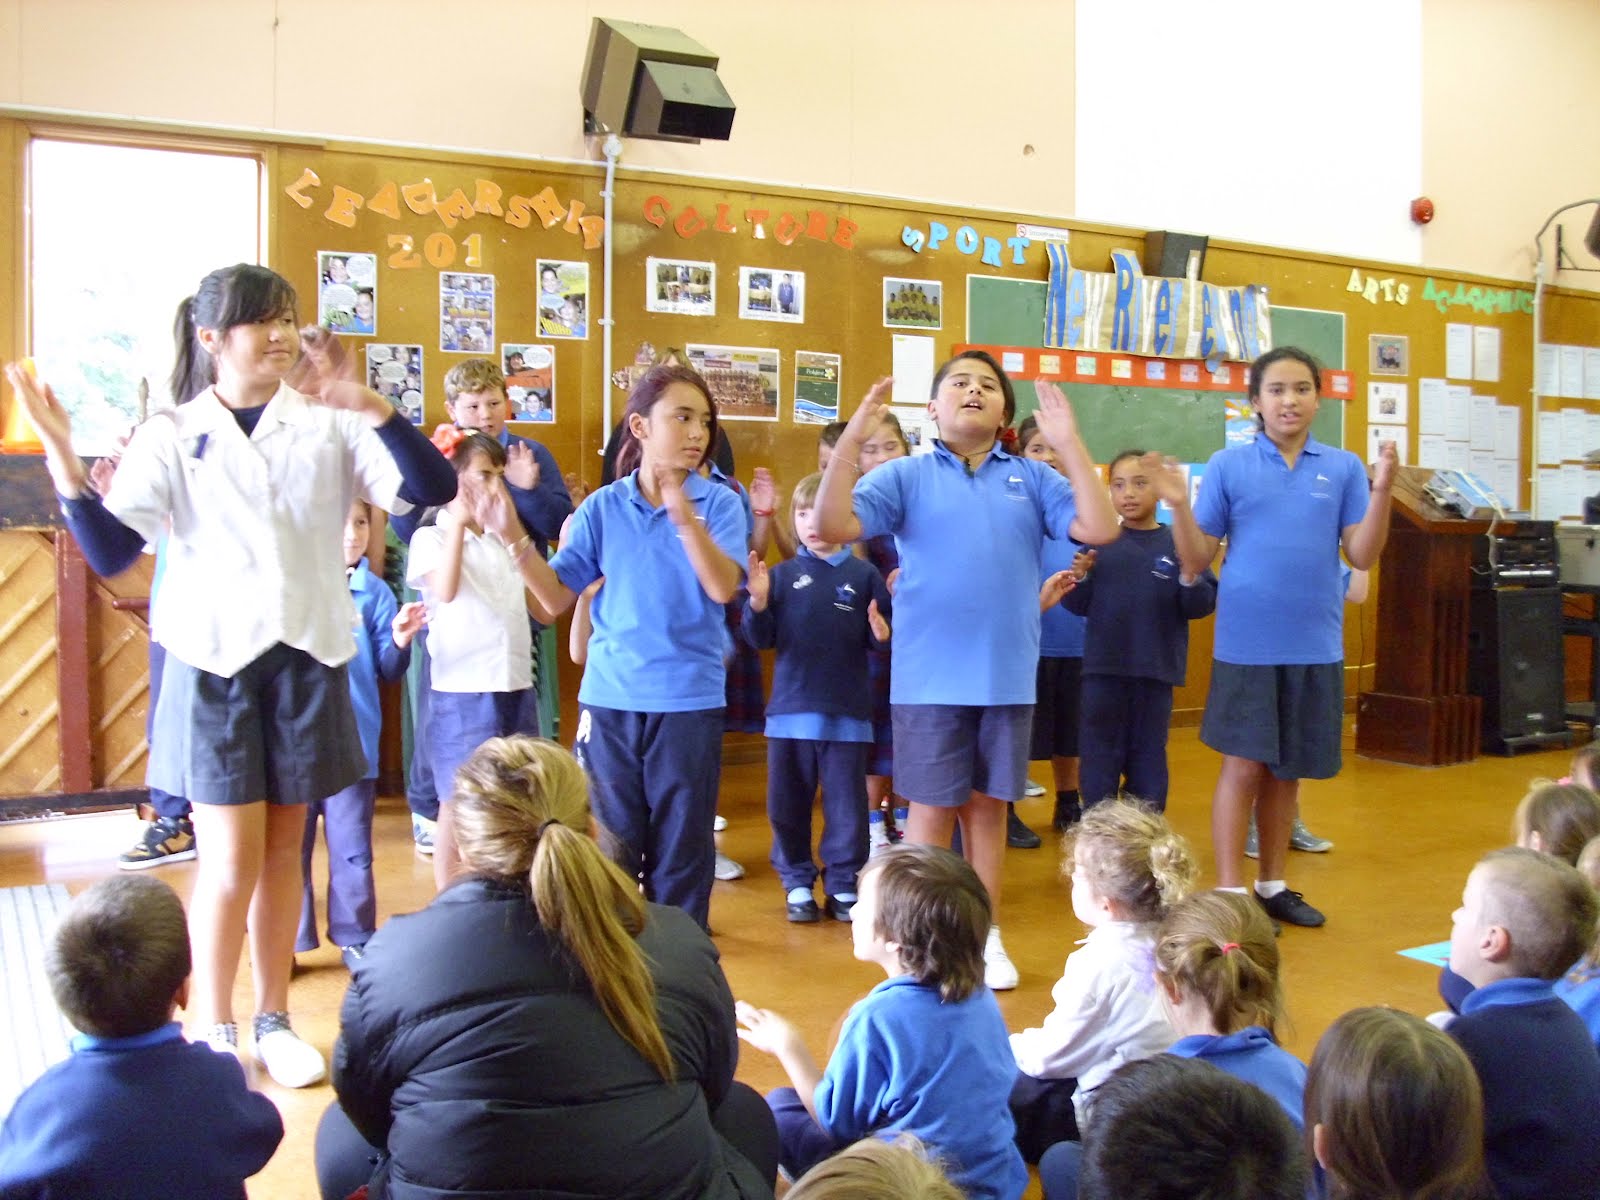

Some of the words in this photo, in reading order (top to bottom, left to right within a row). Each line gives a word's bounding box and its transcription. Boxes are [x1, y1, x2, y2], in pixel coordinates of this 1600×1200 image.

[285, 168, 605, 249] LEADERSHIP
[643, 195, 859, 249] CULTURE
[387, 232, 483, 268] 201
[902, 221, 1030, 267] SPORT
[1045, 243, 1110, 349] New
[1111, 253, 1182, 356] River
[1346, 268, 1410, 305] ARTS
